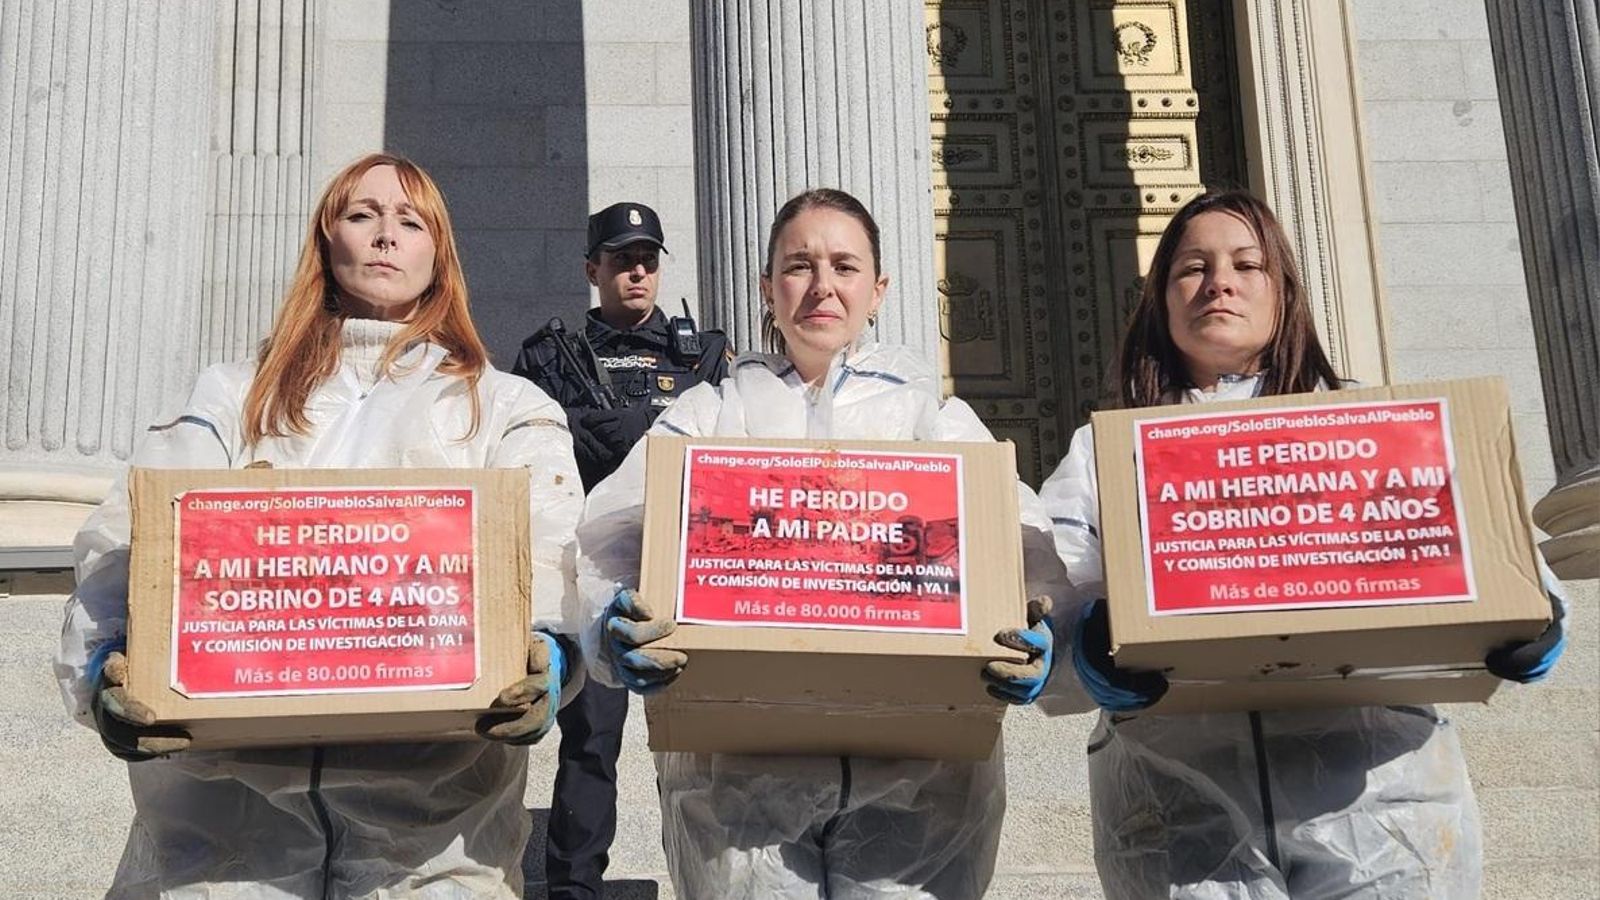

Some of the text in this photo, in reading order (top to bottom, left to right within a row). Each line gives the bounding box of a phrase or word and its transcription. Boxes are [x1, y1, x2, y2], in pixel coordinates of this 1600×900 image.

[1148, 408, 1434, 440] change.org/SoloElPuebloSalvaAlPueblo
[1217, 438, 1378, 468] HE PERDIDO
[1160, 466, 1445, 502] A MI HERMANA Y A MI
[188, 496, 464, 512] change.org/SoloElPuebloSalvaAlPueblo
[750, 487, 908, 511] HE PERDIDO
[1171, 496, 1440, 532] SOBRINO DE 4 AÑOS
[257, 524, 410, 546] HE PERDIDO
[752, 518, 903, 544] A MI PADRE
[1153, 525, 1453, 554] JUSTICIA PARA LAS VÍCTIMAS DE LA DANA
[194, 554, 468, 578] A MI HERMANO Y A MI
[688, 558, 954, 577] JUSTICIA PARA LAS VÍCTIMAS DE LA DANA
[1164, 560, 1174, 572] Y
[1177, 554, 1255, 571] COMISIÓN
[1258, 554, 1280, 568] DE
[1282, 546, 1405, 566] INVESTIGACIÓN
[696, 576, 704, 586] Y
[709, 574, 778, 588] COMISIÓN
[782, 578, 800, 589] DE
[804, 578, 911, 592] INVESTIGACIÓN
[1210, 576, 1421, 600] Más de 80.000 firmas
[204, 582, 460, 611] SOBRINO DE 4 AÑOS
[734, 601, 920, 621] Más de 80.000 firmas
[182, 615, 467, 634] JUSTICIA PARA LAS VÍCTIMAS DE LA DANA
[192, 641, 201, 652] Y
[204, 637, 282, 652] COMISIÓN
[286, 640, 306, 651] DE
[310, 633, 424, 650] INVESTIGACIÓN
[234, 662, 433, 684] Más de 80.000 firmas
